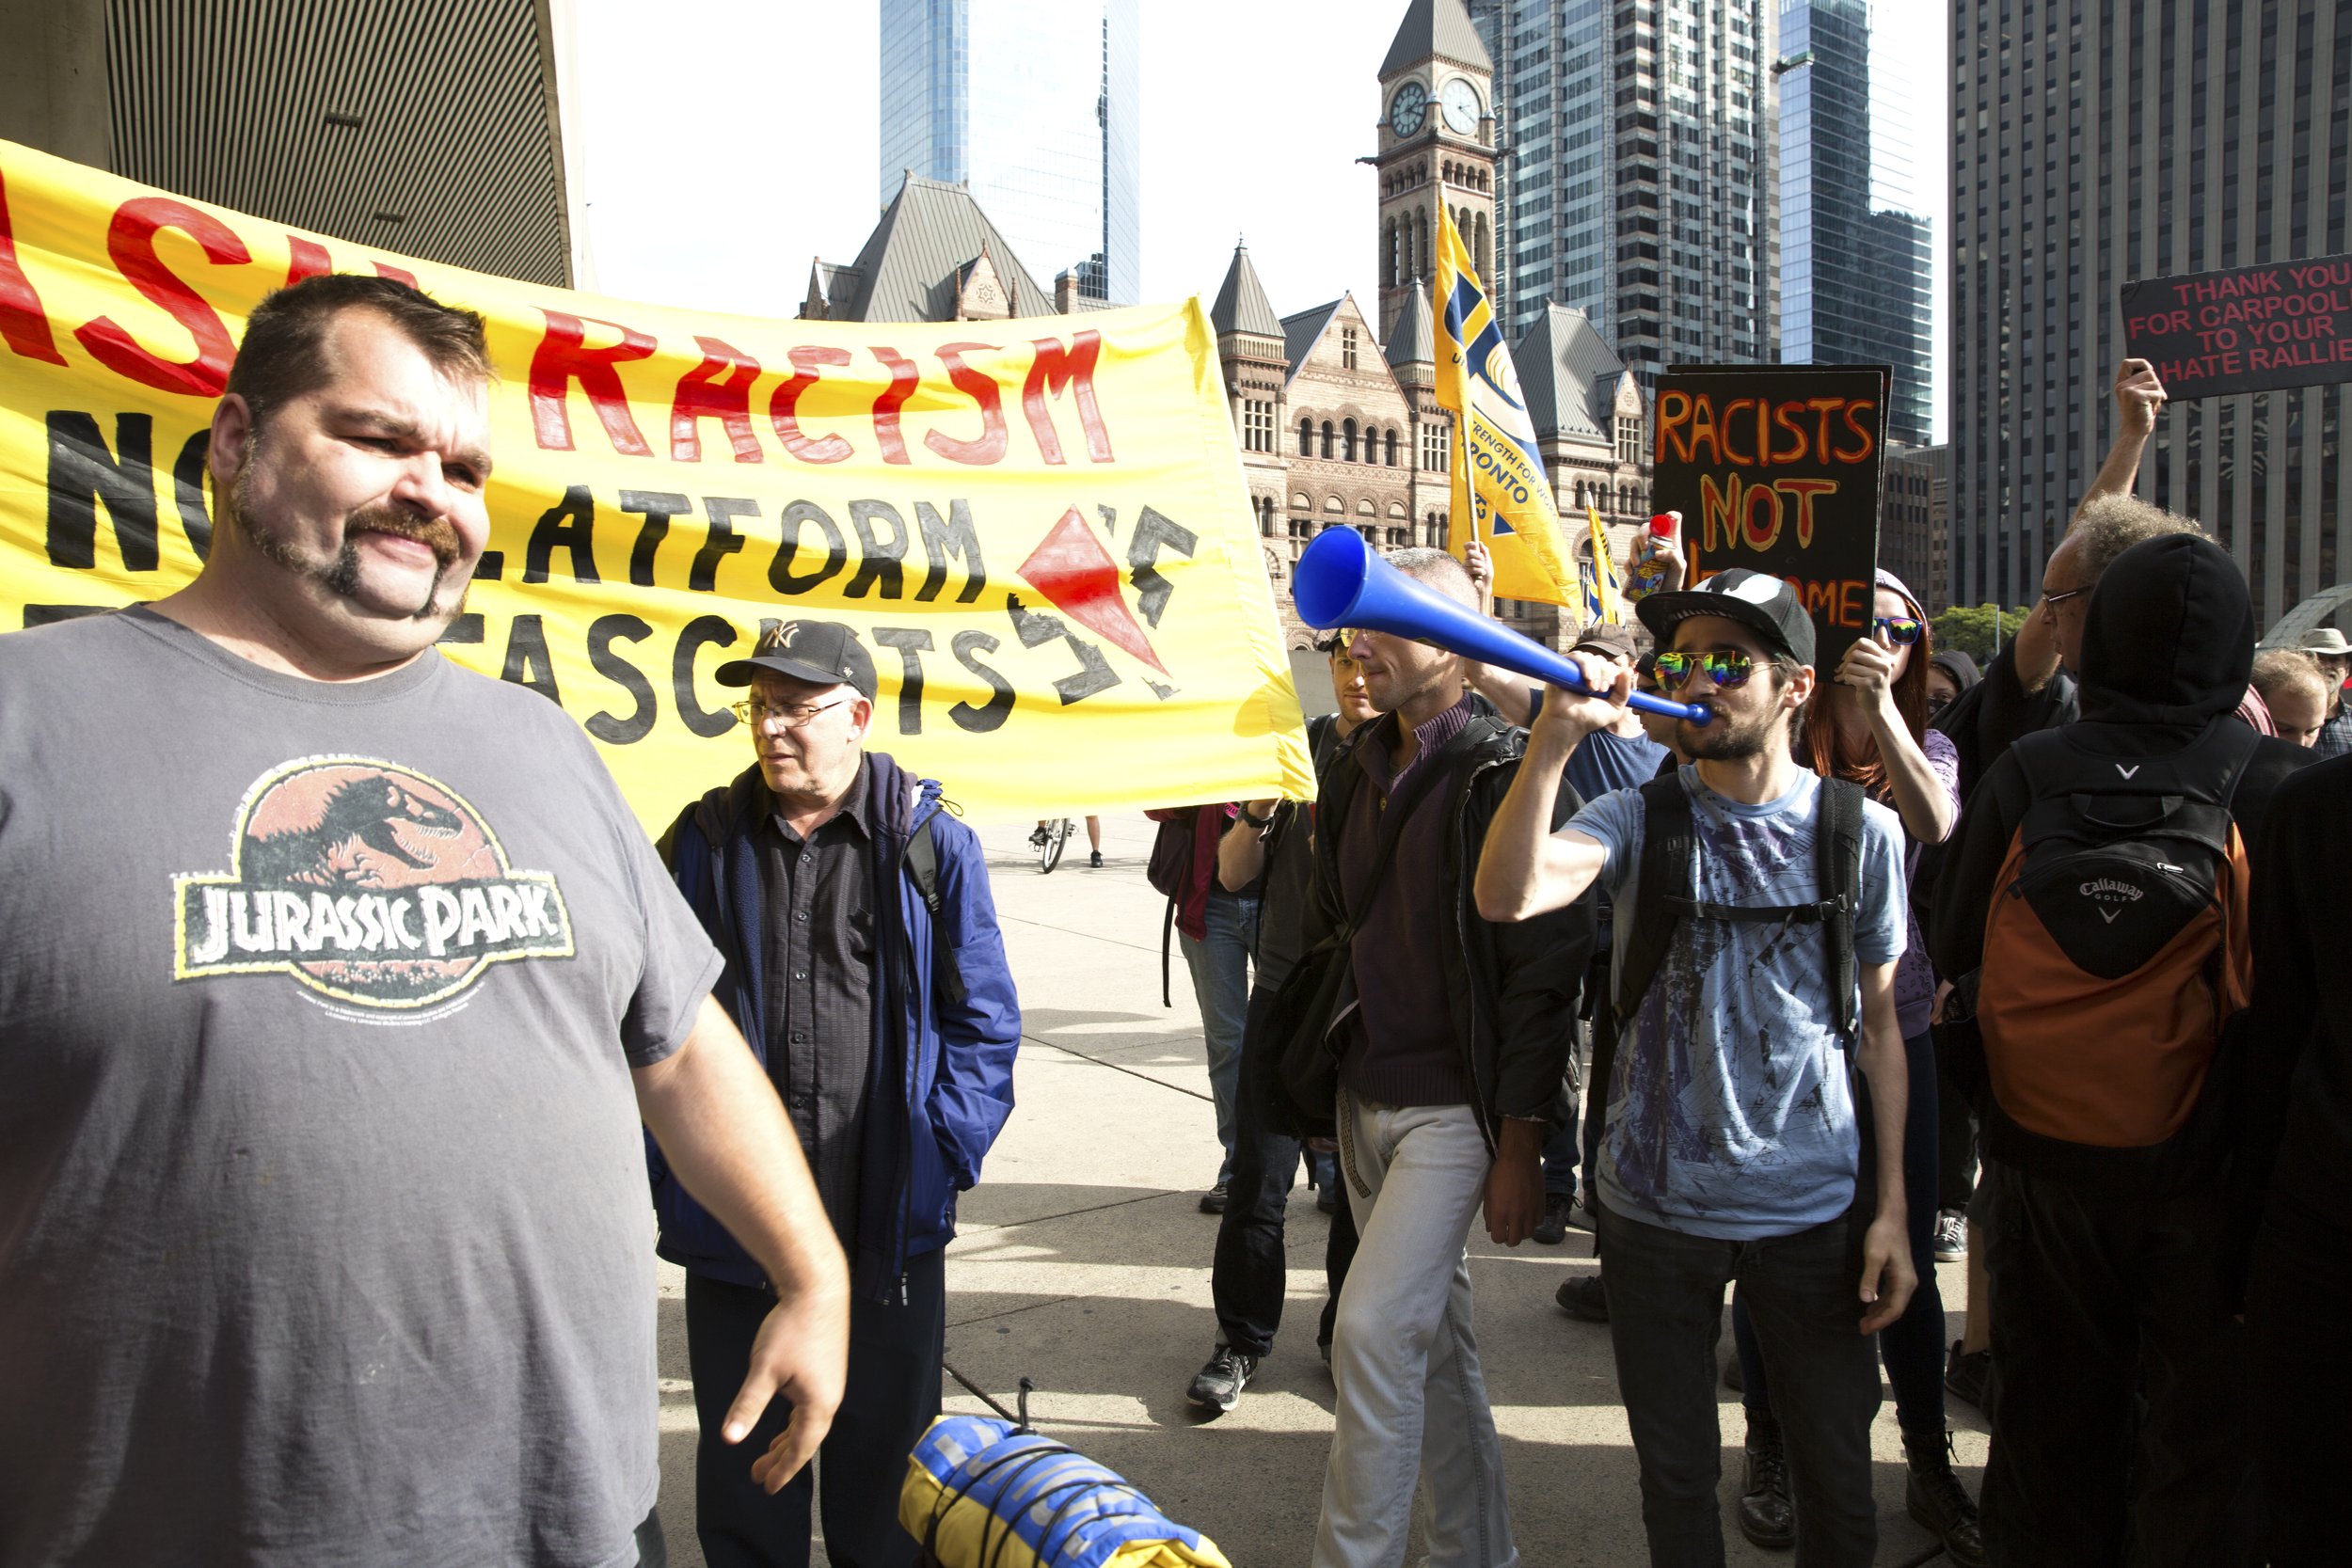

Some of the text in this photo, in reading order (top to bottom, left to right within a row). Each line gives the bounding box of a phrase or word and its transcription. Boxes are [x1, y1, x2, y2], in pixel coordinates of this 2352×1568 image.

[2172, 262, 2352, 306] THANK YOU
[2129, 309, 2192, 340] FOR
[2195, 315, 2335, 353] TO YOUR
[2160, 339, 2352, 383] HATE RALLIE
[528, 305, 1116, 467] RACISM
[1654, 389, 1876, 467] RACISTS
[1469, 441, 1529, 504] RONTO
[1516, 462, 1536, 486] FOR
[1699, 472, 1839, 553] NOT
[2079, 877, 2144, 902] Callaway
[2093, 893, 2128, 902] GOLF
[191, 883, 561, 965] JURASSIC PARK
